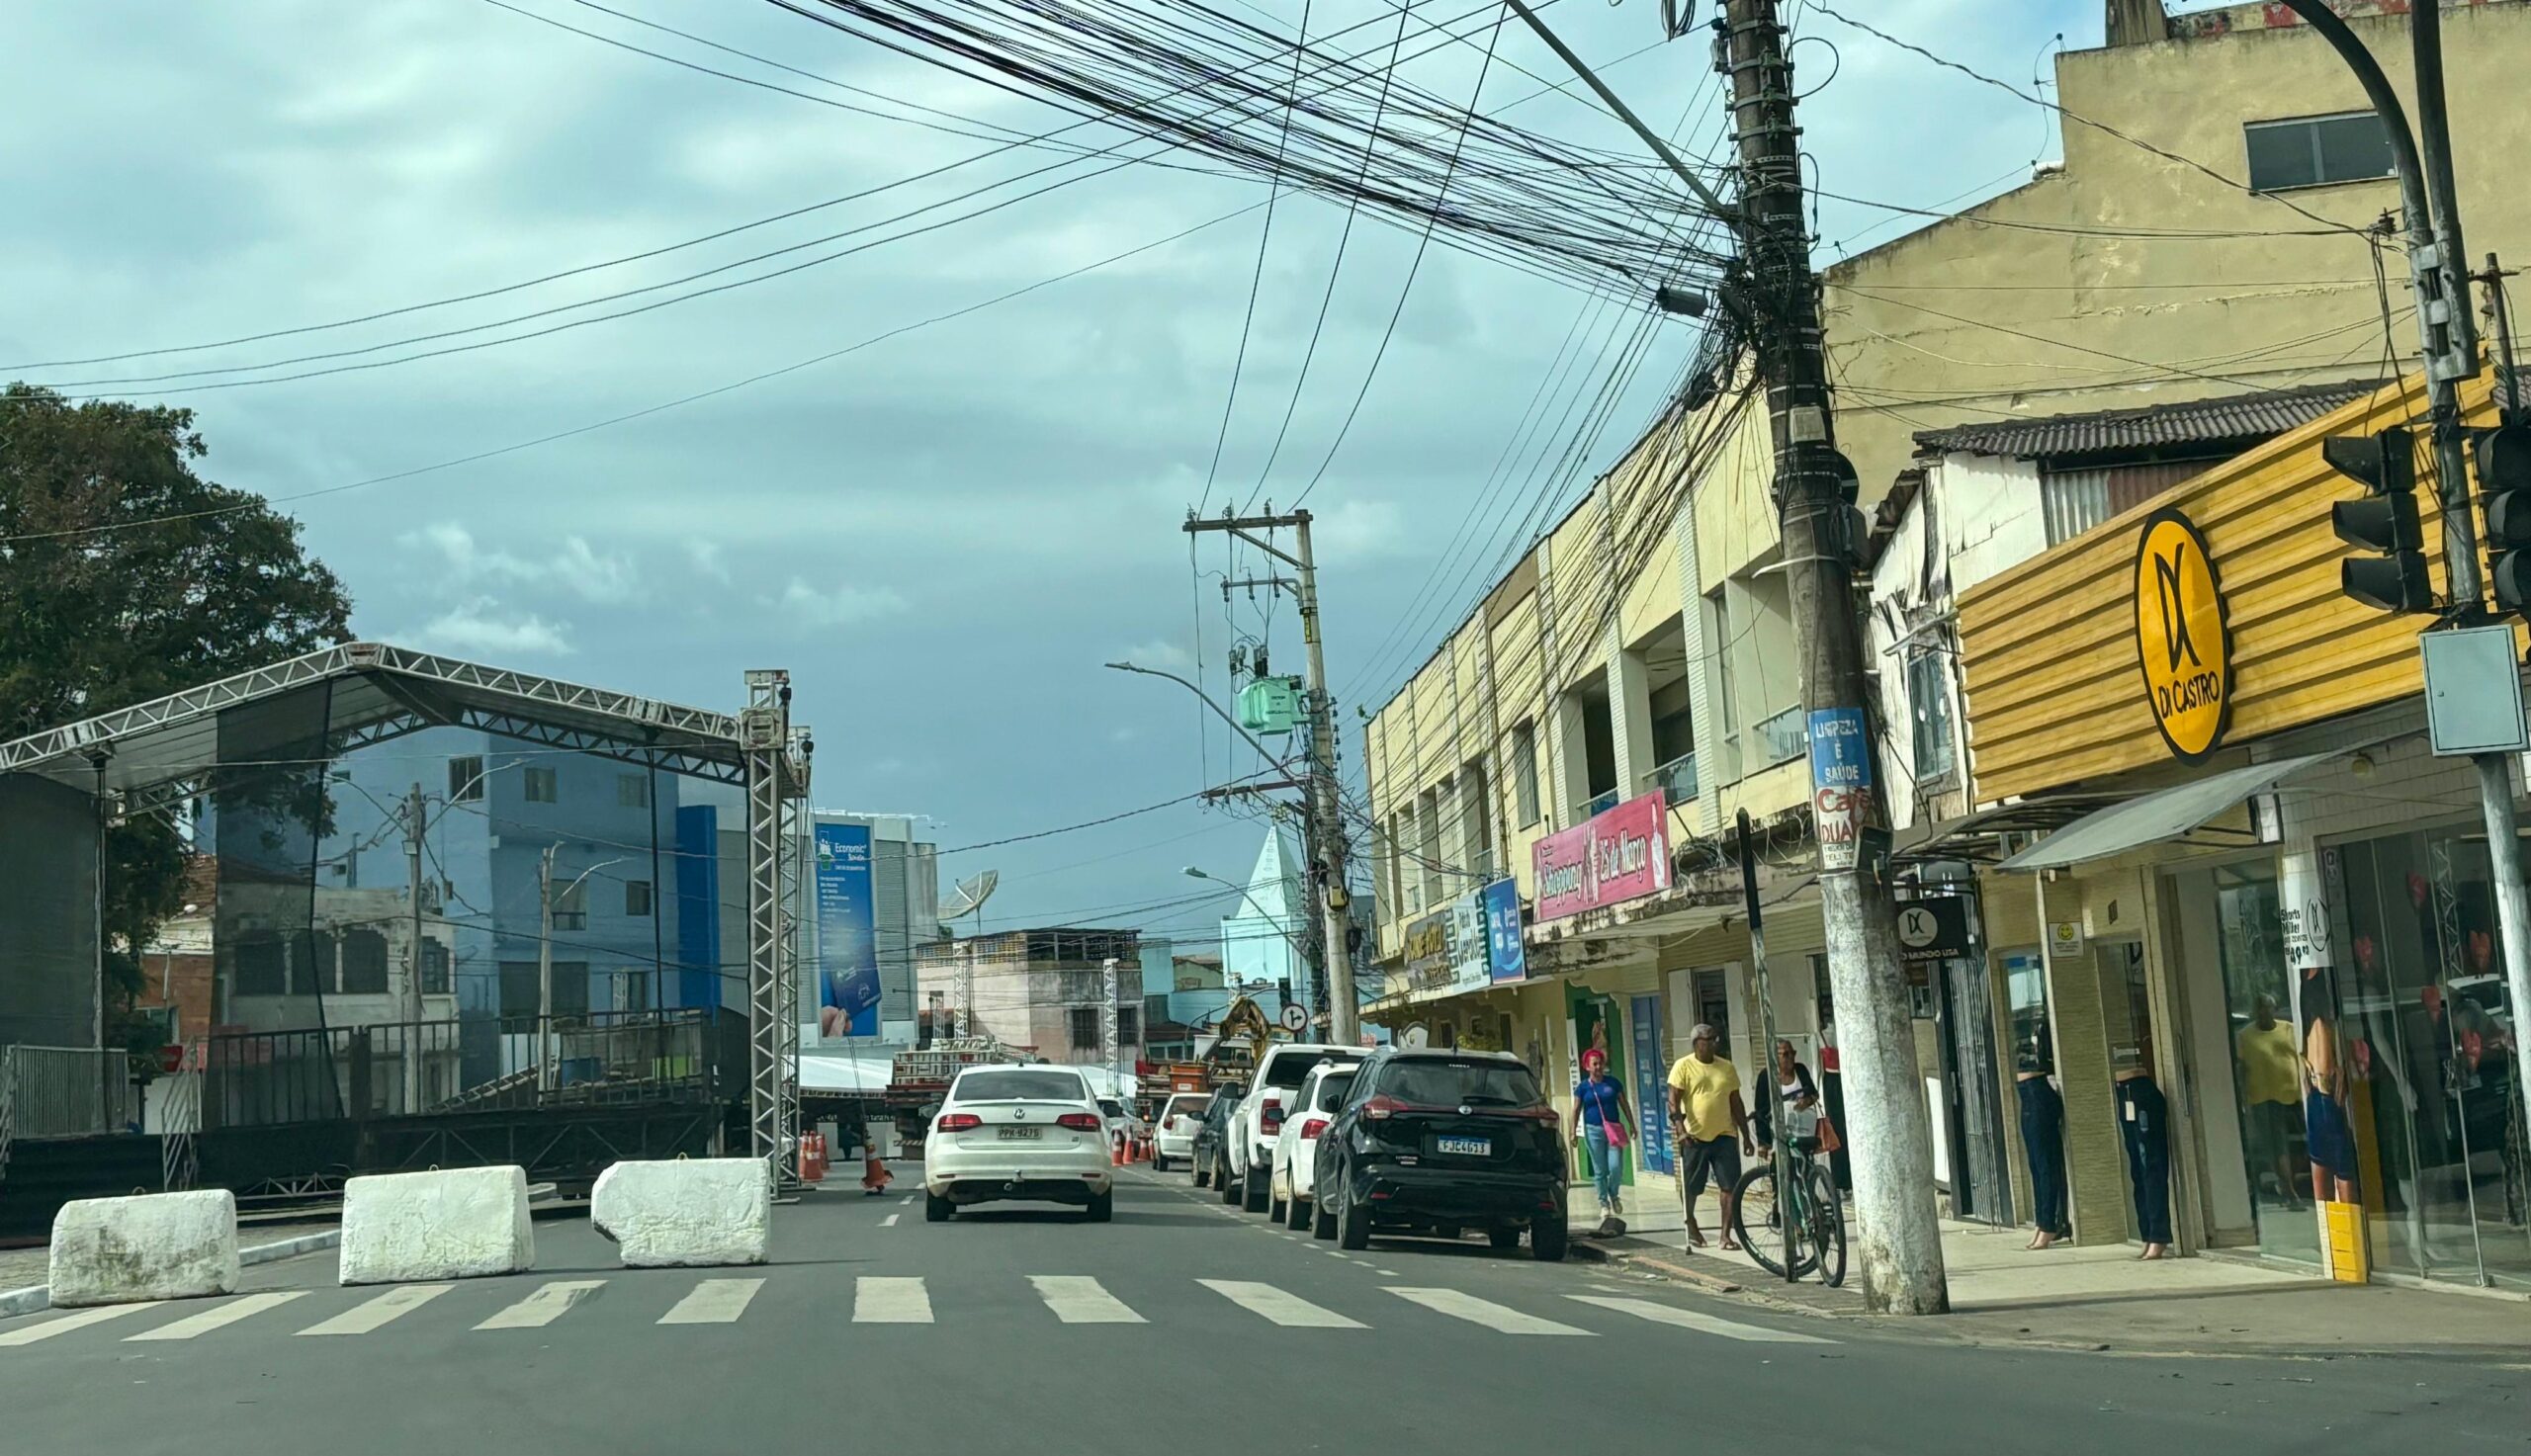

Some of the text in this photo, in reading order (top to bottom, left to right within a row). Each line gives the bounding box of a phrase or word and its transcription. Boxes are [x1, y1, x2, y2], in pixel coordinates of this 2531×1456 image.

[2158, 671, 2220, 719] DI CASTRO
[1824, 761, 1860, 783] SAÚDE
[1543, 860, 1583, 906] Shopping
